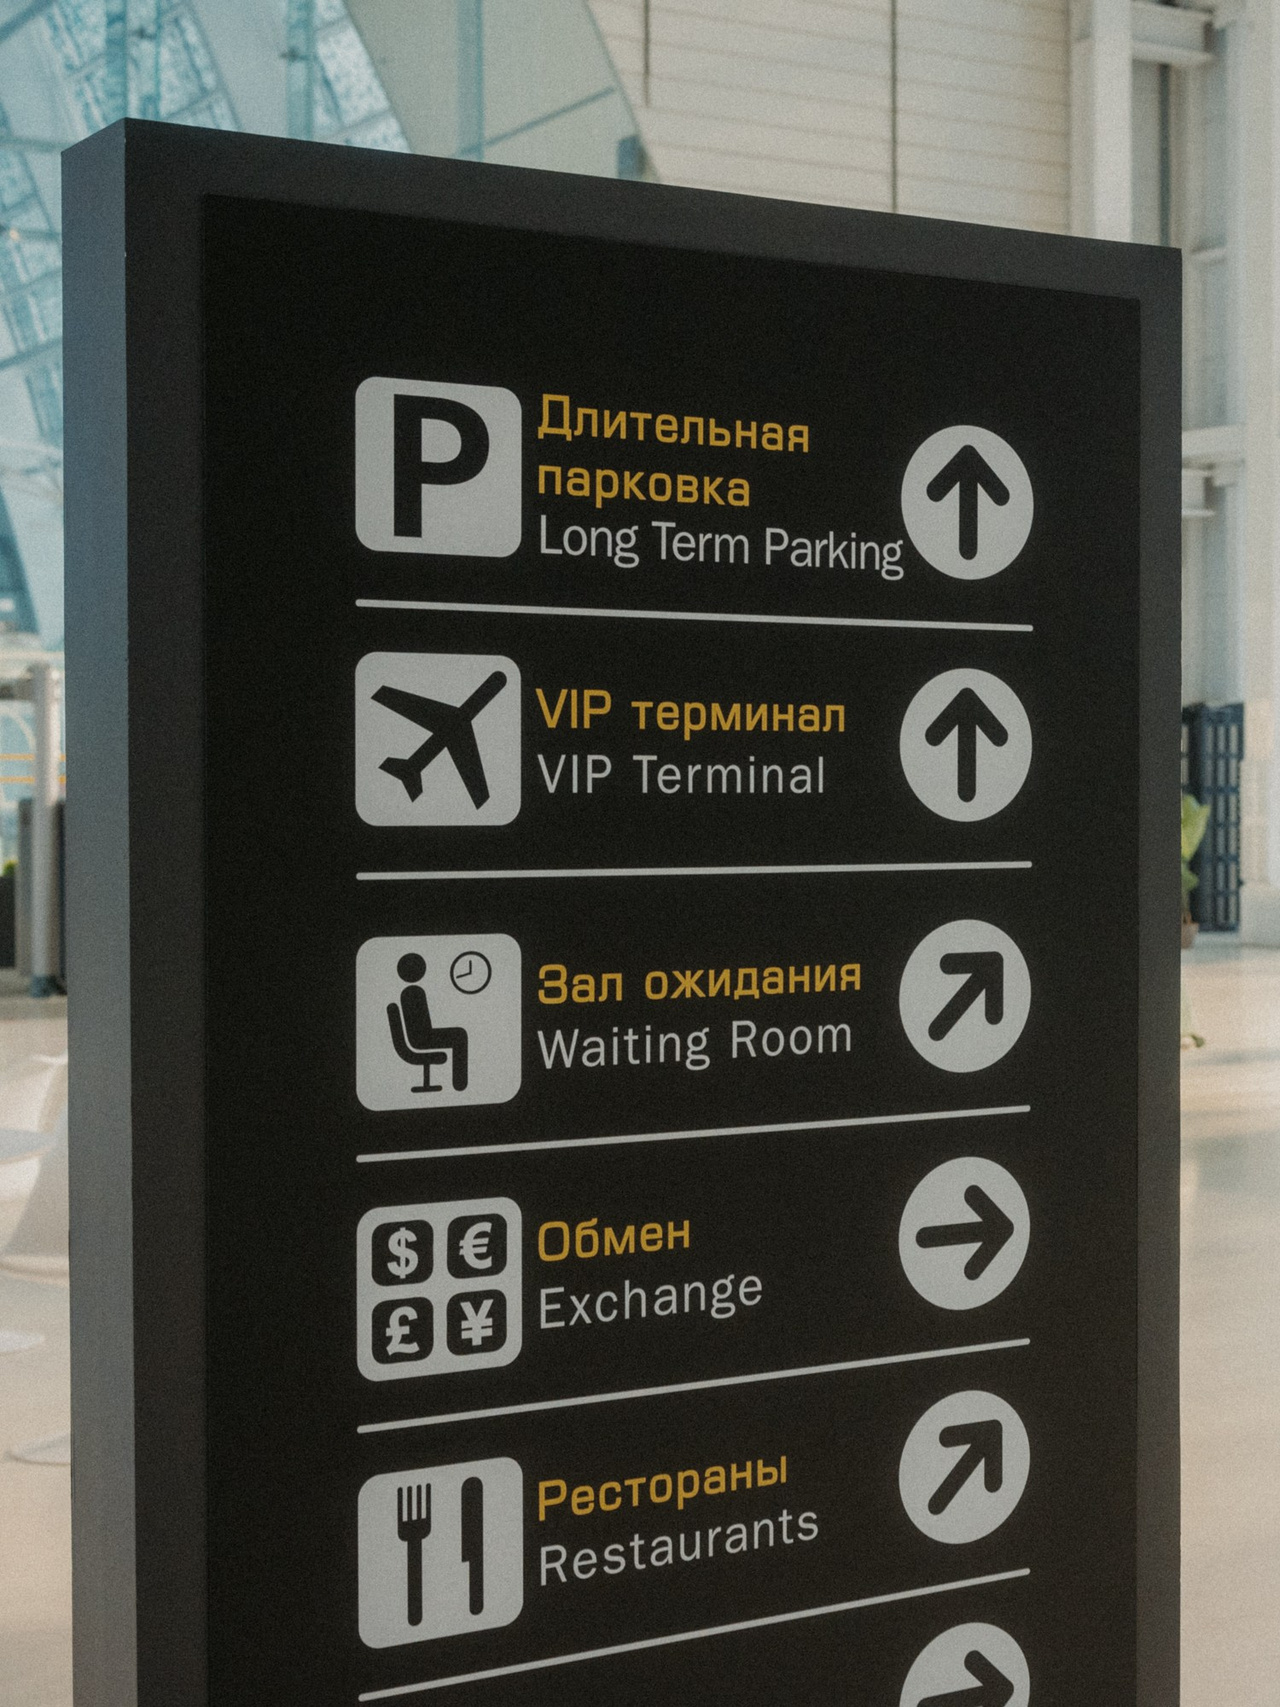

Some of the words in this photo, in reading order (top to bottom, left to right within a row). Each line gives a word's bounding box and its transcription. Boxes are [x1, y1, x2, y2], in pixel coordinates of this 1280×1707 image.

[537, 393, 809, 453] Длительная
[394, 393, 490, 538] P
[538, 464, 750, 509] парковка
[540, 514, 640, 569] Long
[651, 520, 749, 564] Term
[765, 527, 905, 581] Parking
[535, 688, 612, 729] VIP
[631, 701, 845, 741] терминал
[537, 754, 612, 794] VIP
[632, 754, 825, 794] Terminal
[537, 963, 623, 1005] Зал
[644, 963, 862, 1001] ожидания
[537, 1027, 711, 1071] Waiting
[731, 1020, 853, 1059] Room
[537, 1217, 691, 1262] Обмен
[539, 1273, 763, 1329] Exchange
[538, 1455, 789, 1521] Рестораны
[538, 1506, 819, 1586] Restaurants
